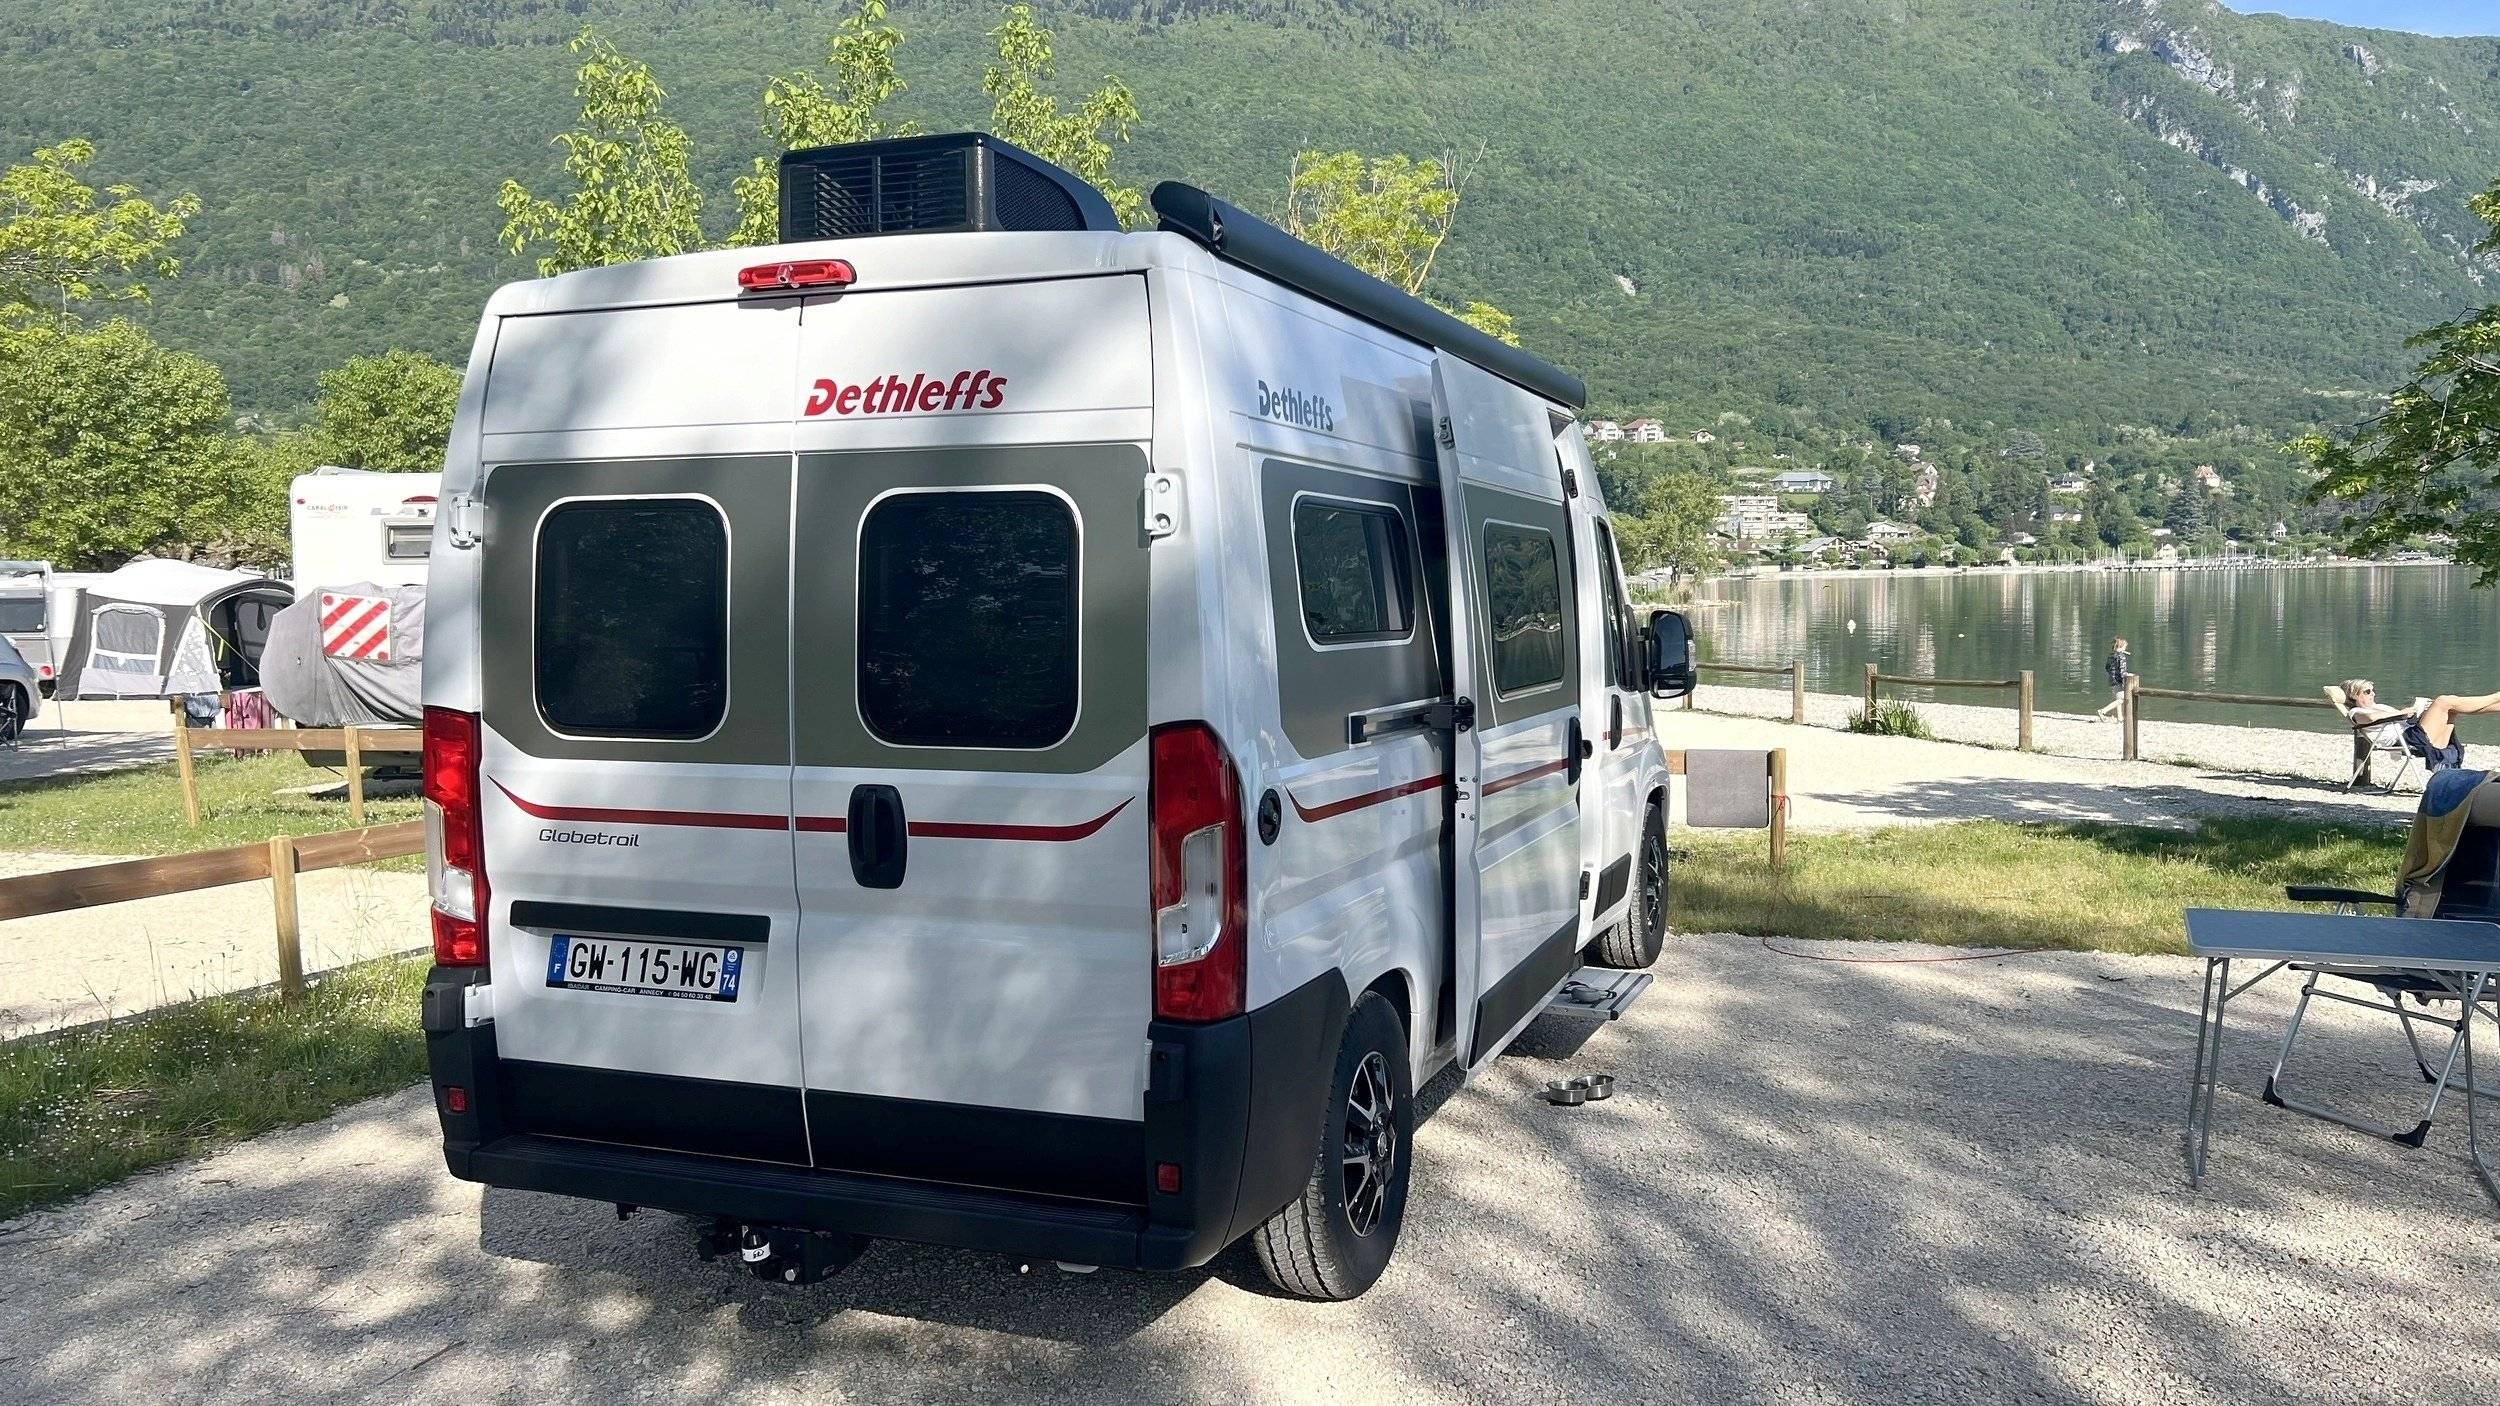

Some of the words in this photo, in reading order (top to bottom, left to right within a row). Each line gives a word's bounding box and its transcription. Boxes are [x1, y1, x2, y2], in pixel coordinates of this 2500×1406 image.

[804, 369, 1008, 416] Dethleffs
[1258, 379, 1334, 432] Dethleffs
[539, 828, 640, 847] Globetrail
[554, 963, 562, 974] F
[570, 942, 718, 989] GW-115-WG
[594, 985, 636, 994] CAMPING-CAR
[639, 988, 664, 996] ANNECY
[722, 974, 736, 991] 74
